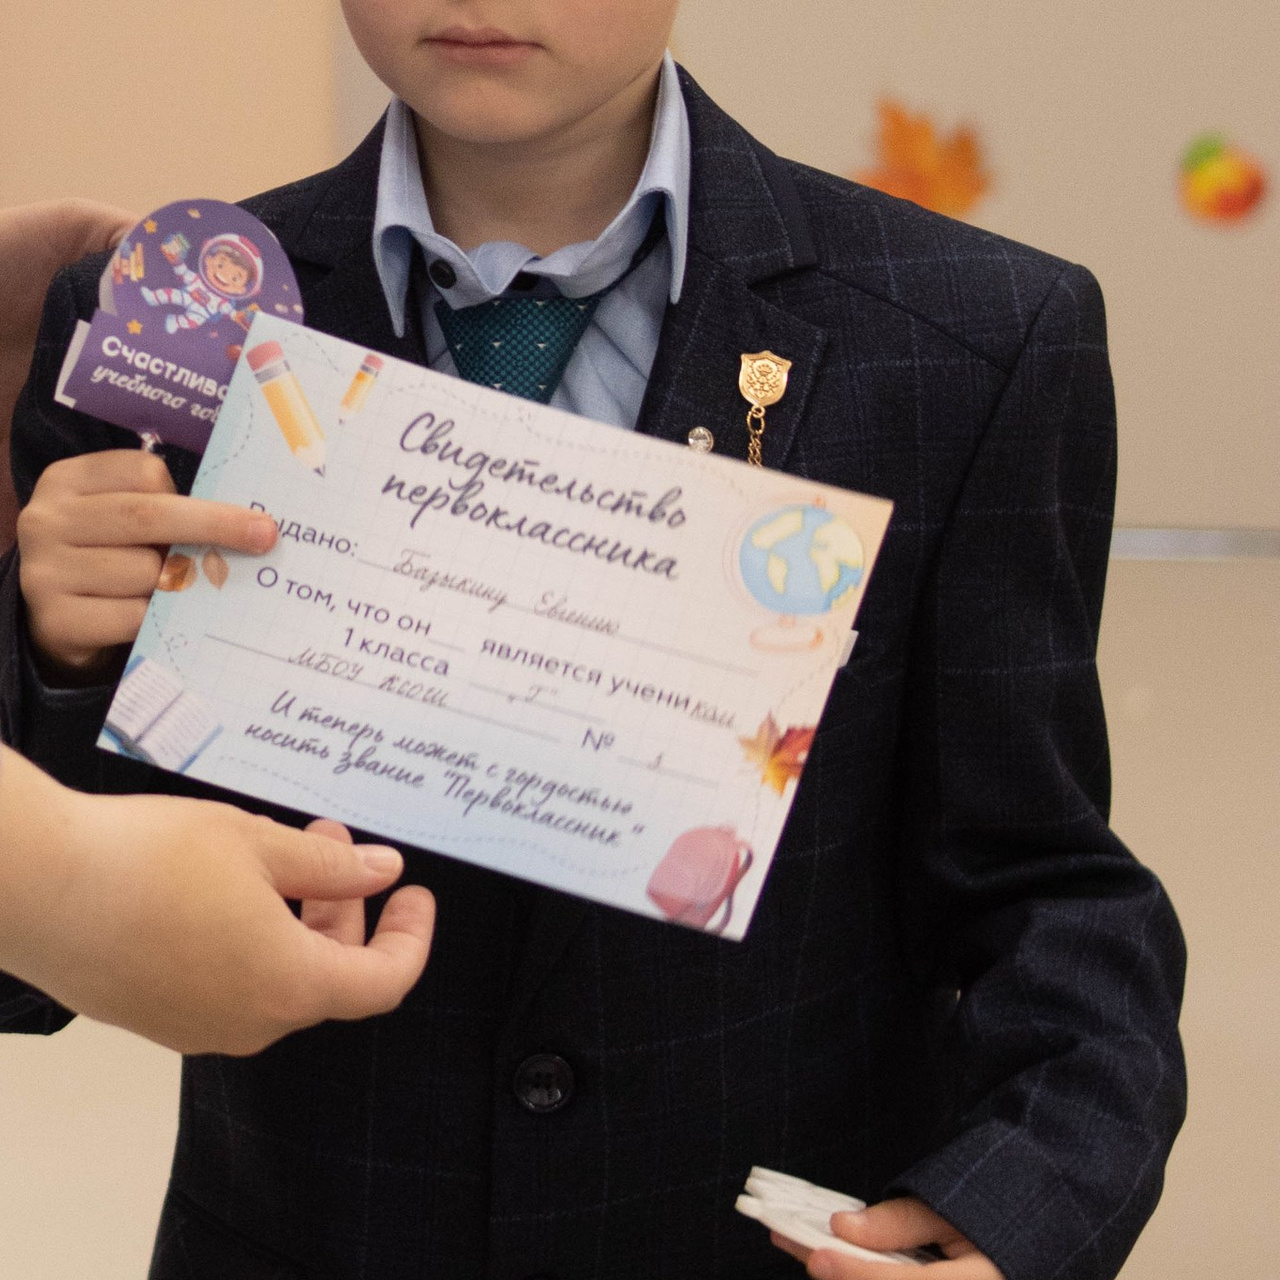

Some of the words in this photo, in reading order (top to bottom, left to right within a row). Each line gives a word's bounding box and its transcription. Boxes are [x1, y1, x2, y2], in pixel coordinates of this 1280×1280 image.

[90, 365, 187, 409] учебного
[399, 412, 687, 528] Свидетельство
[381, 474, 679, 579] первоклассника
[257, 567, 278, 588] О
[286, 579, 336, 612] том,
[347, 598, 390, 624] что
[398, 614, 432, 636] он
[481, 638, 602, 687] является
[345, 627, 354, 648] 1
[359, 637, 450, 676] класса
[245, 723, 330, 759] носить
[333, 746, 425, 788] звание
[271, 690, 297, 718] И
[298, 707, 384, 751] теперь
[393, 736, 480, 771] может
[486, 763, 498, 778] с
[504, 767, 633, 815] гордостью
[581, 727, 615, 752] №
